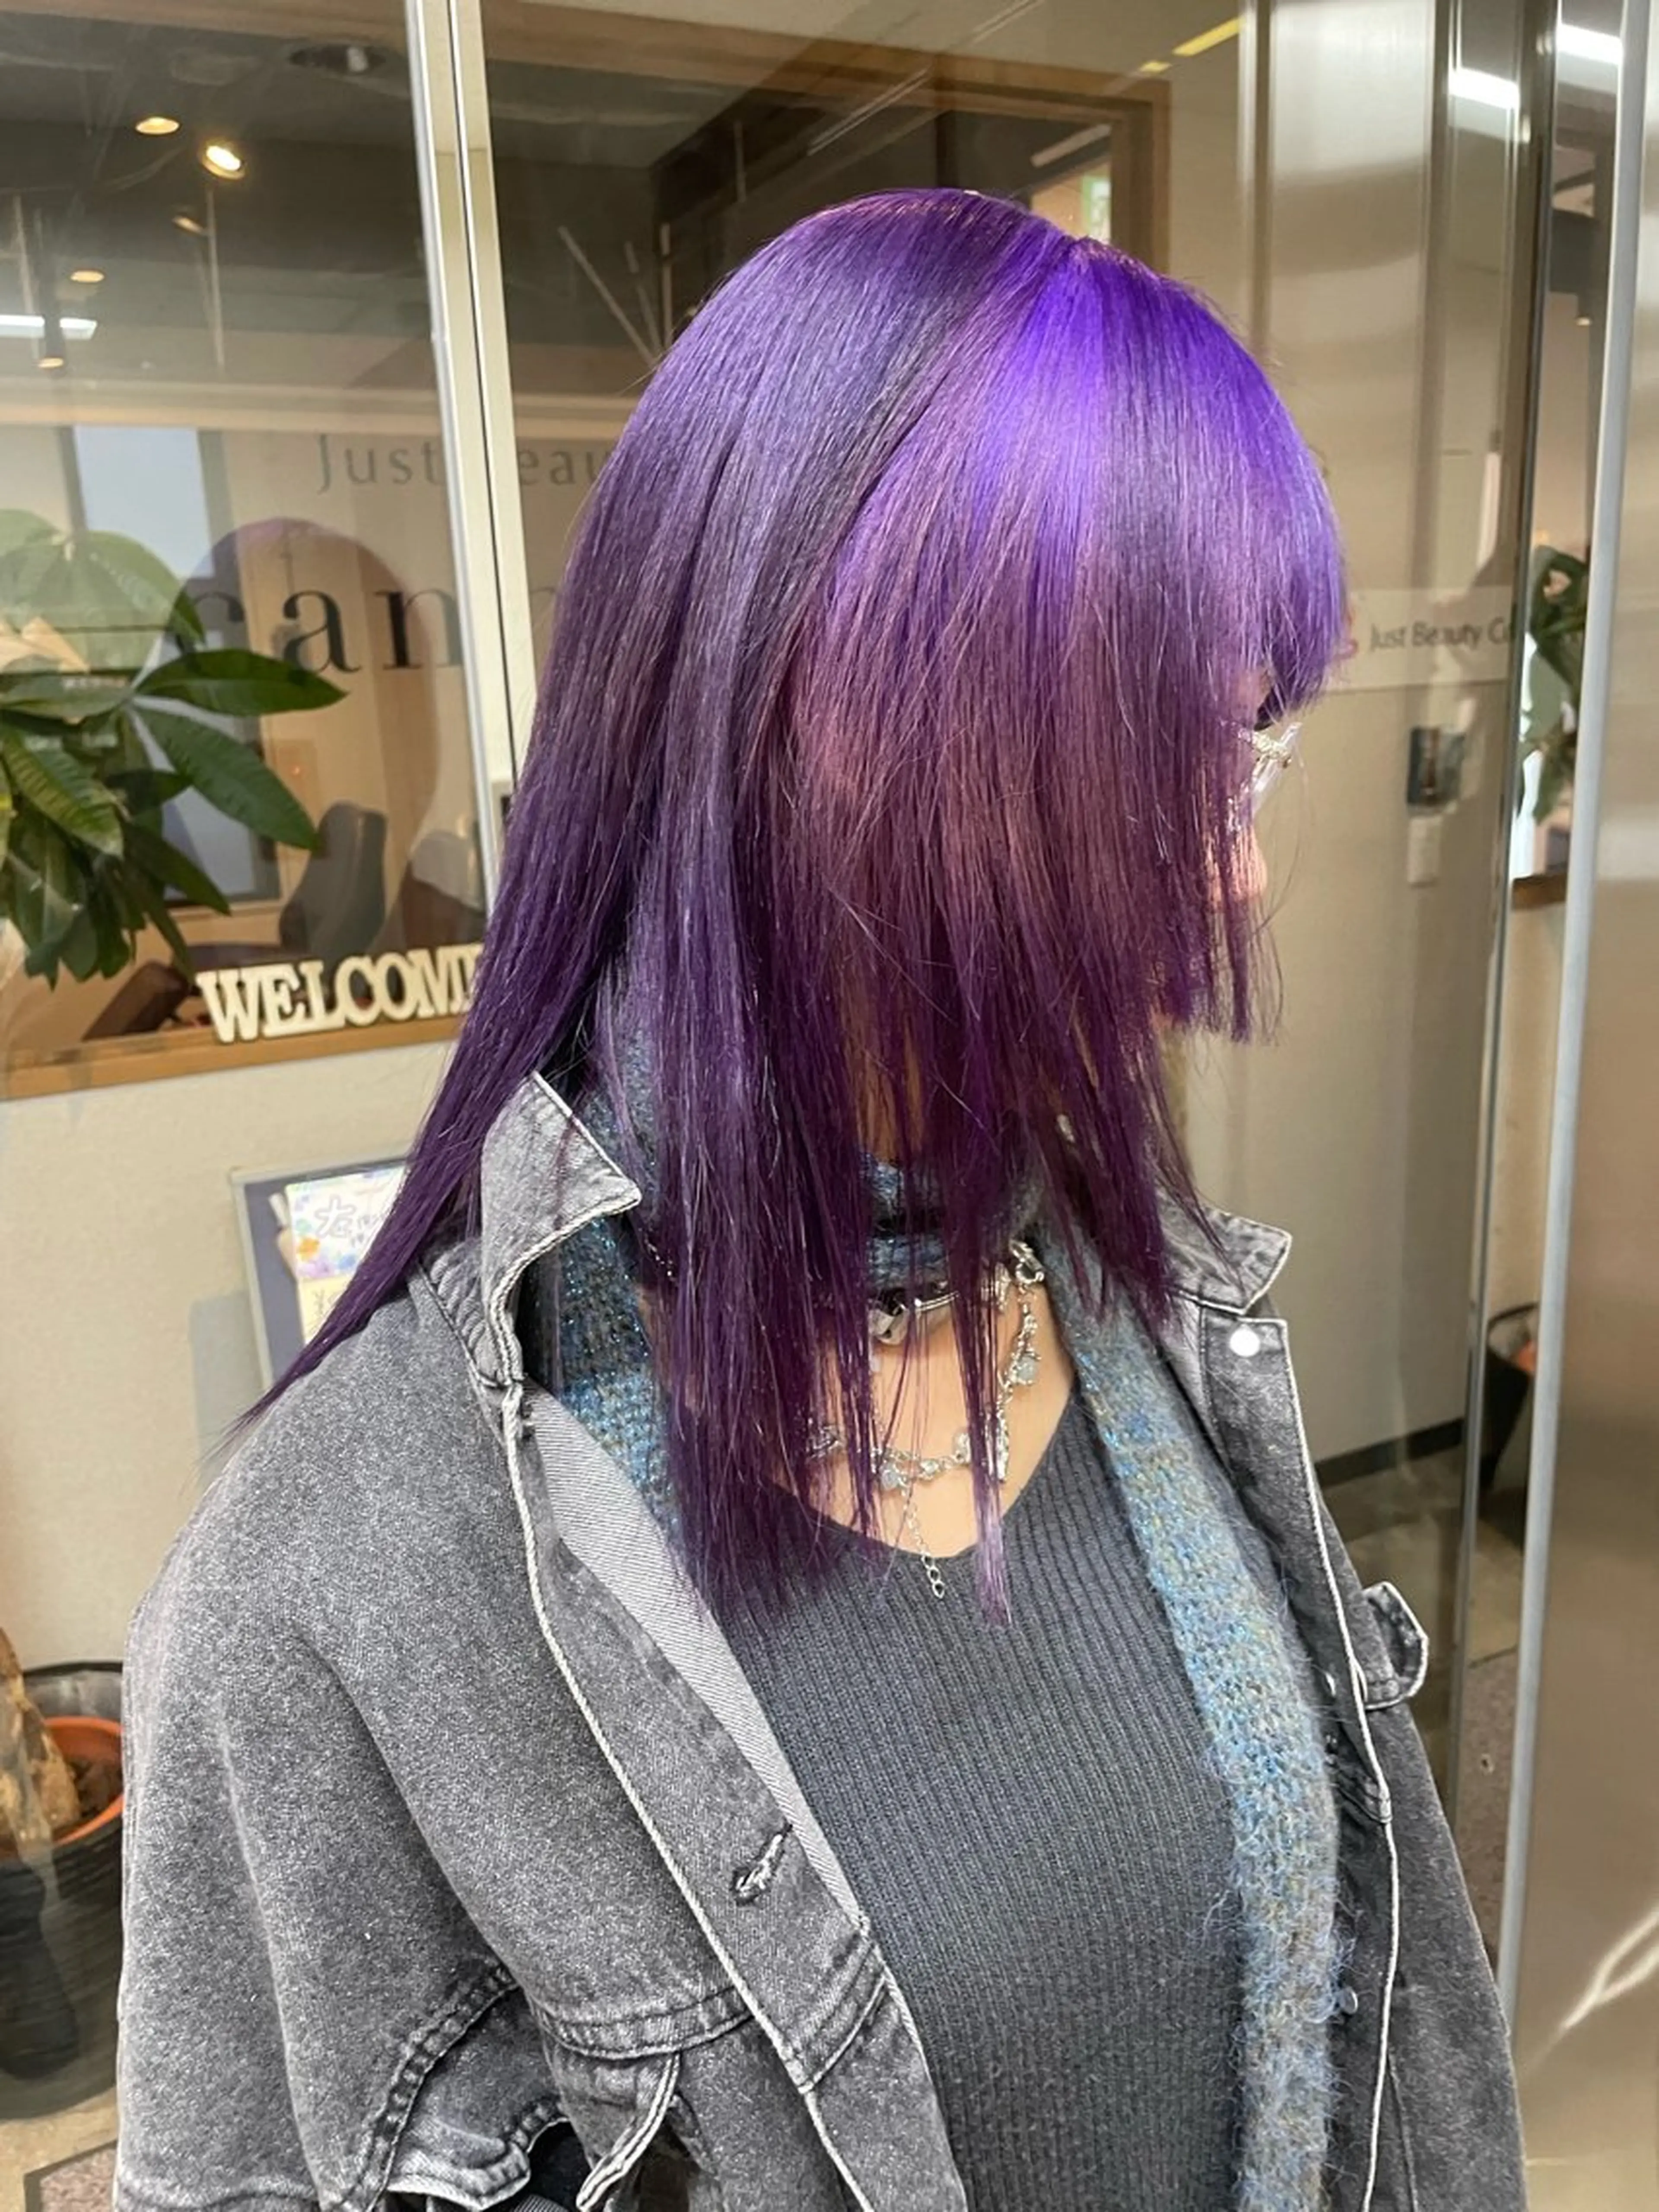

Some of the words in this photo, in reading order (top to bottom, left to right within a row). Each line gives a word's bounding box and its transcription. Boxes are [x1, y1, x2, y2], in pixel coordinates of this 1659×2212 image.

[317, 433, 445, 493] Just
[1371, 624, 1405, 652] Just
[1412, 620, 1482, 649] Beauty
[196, 944, 484, 1042] WELCOM
